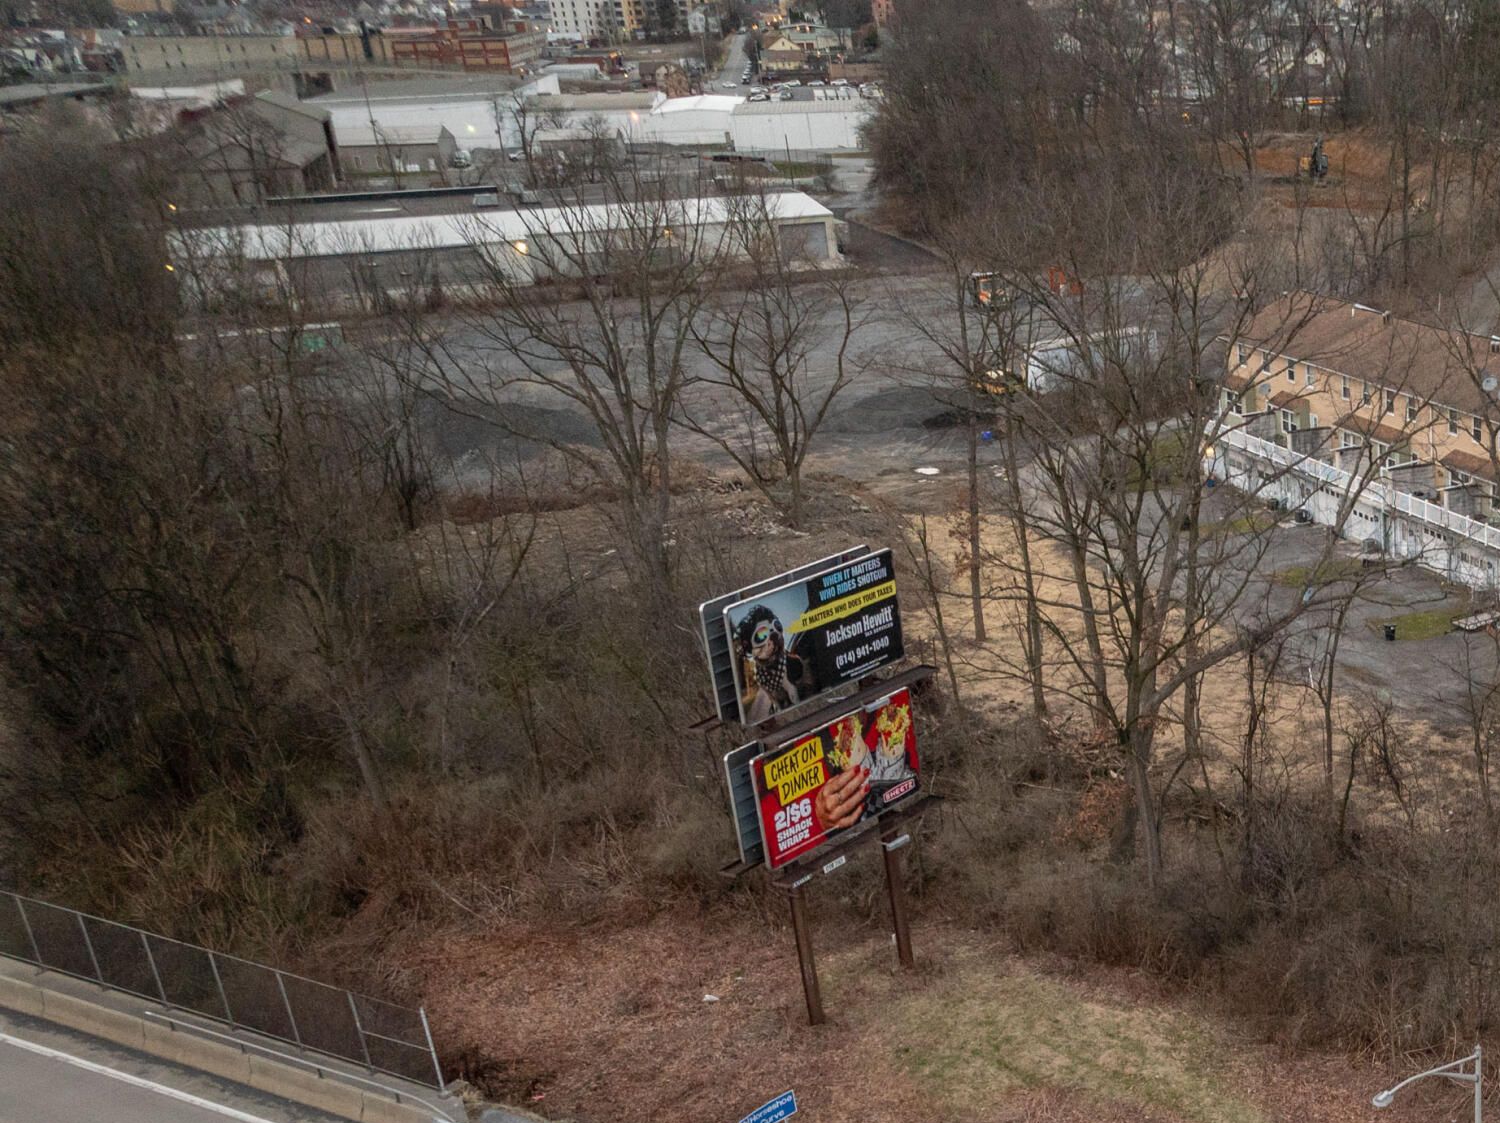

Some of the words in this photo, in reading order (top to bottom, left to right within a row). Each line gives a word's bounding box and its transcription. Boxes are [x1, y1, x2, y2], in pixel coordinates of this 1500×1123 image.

[819, 587, 836, 602] WHO
[837, 579, 856, 595] RIDES
[857, 568, 887, 587] SHOTGUN
[822, 572, 843, 587] WHEN
[844, 568, 850, 578] IT
[852, 558, 881, 576] MATTERS
[802, 618, 807, 627] IT
[809, 608, 834, 624] MATTERS
[834, 602, 847, 614] WHO
[848, 598, 862, 609] DOES
[863, 592, 877, 603] YOUR
[878, 585, 893, 597] TAXES
[826, 621, 863, 647] Jackson
[863, 608, 893, 631] Hewitt
[836, 650, 856, 670] (814)
[856, 636, 890, 658] 941-1040
[770, 750, 800, 782] CHEAT
[802, 742, 817, 766] ON
[781, 766, 820, 798] DINNER
[886, 780, 915, 801] SHEETZ
[774, 798, 812, 832] 2/$6
[776, 818, 813, 842] SHNACK
[778, 830, 810, 852] WRAPZ
[750, 1094, 792, 1123] Horseshoe
